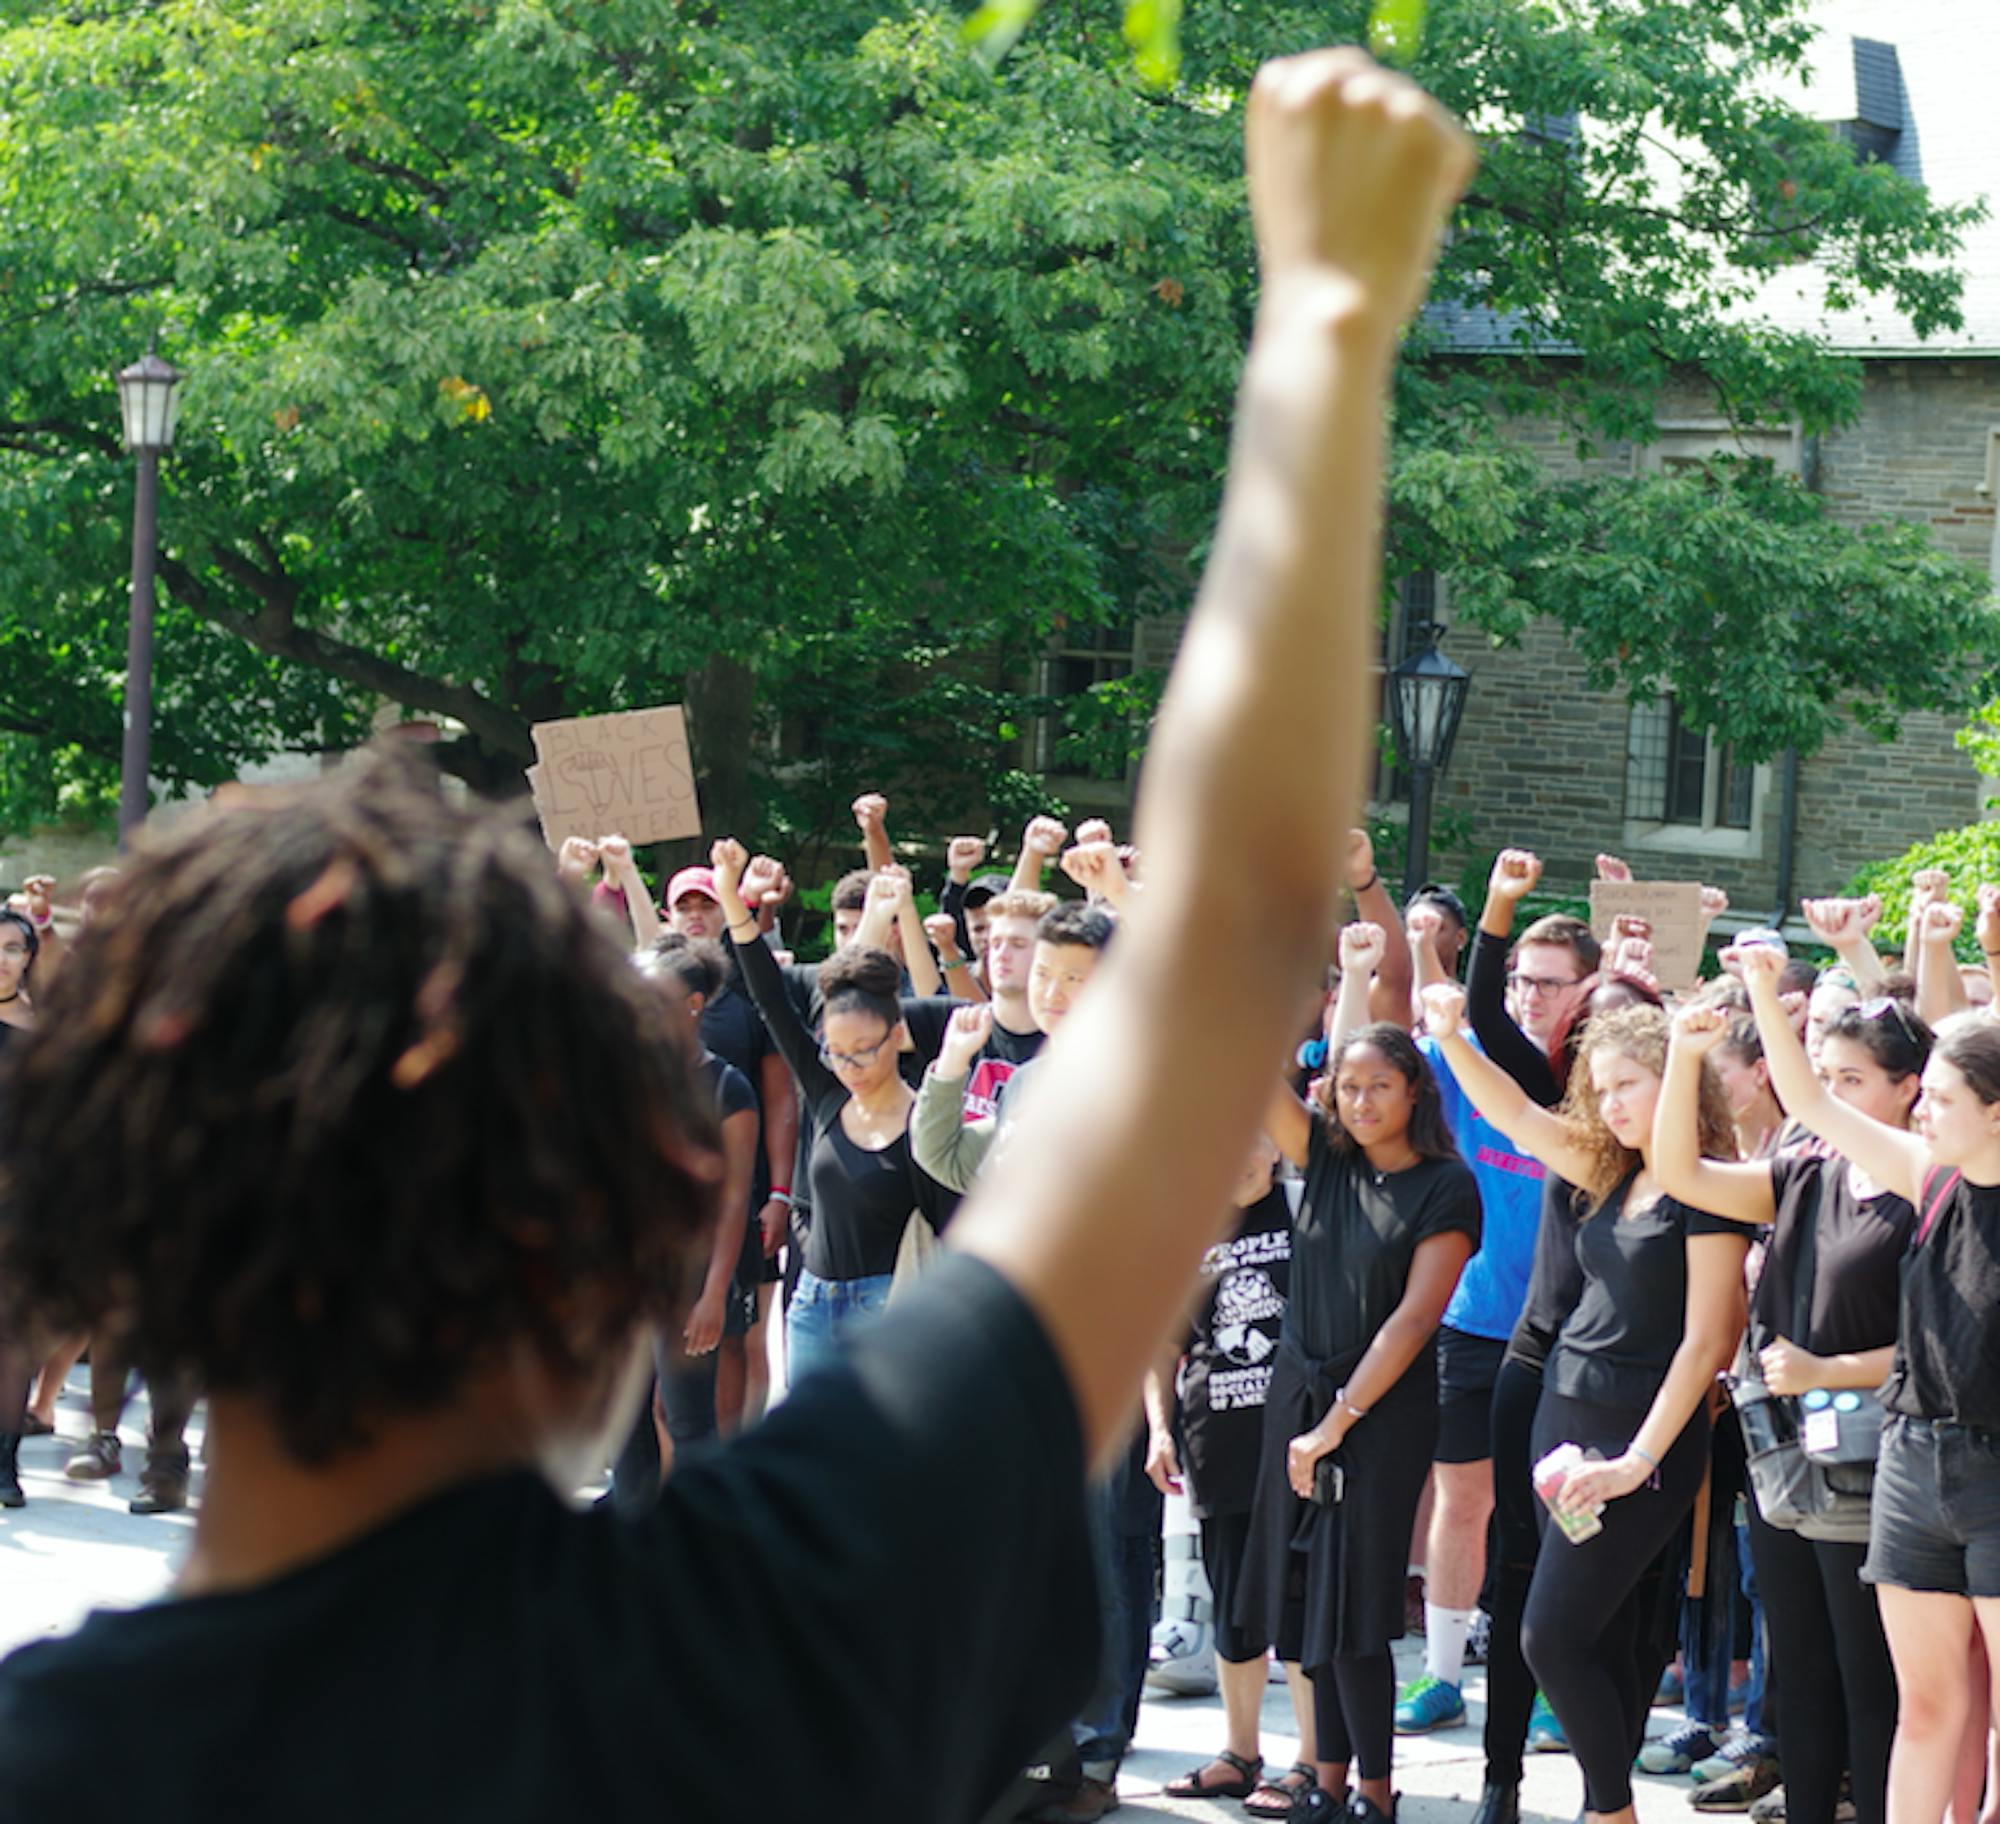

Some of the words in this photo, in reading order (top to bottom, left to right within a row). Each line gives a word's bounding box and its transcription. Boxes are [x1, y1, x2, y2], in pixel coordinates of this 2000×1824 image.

[546, 715, 660, 757] BLACK
[569, 806, 683, 842] MATTER
[1203, 1229, 1289, 1264] PEOPLE
